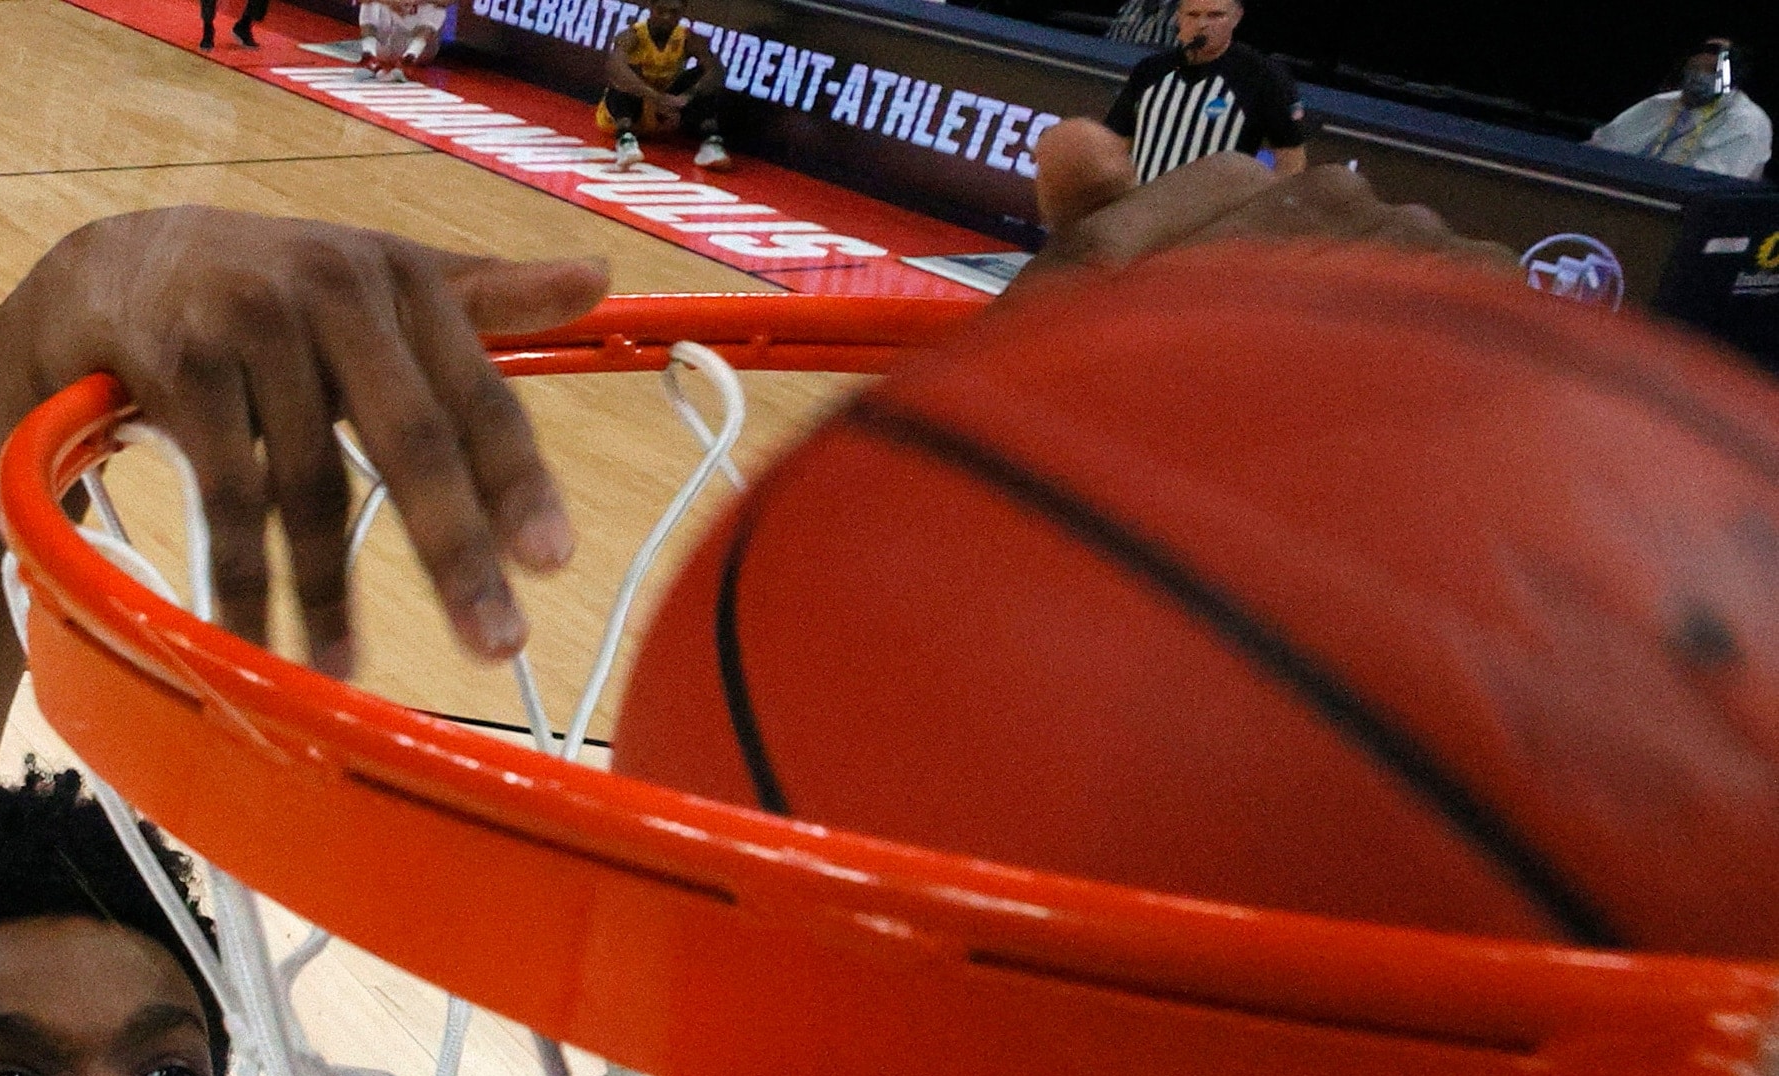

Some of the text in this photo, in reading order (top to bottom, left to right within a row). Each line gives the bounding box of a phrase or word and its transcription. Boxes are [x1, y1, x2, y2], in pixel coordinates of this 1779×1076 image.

[270, 66, 889, 258] INDIANAPOLIS
[472, 0, 1061, 179] LEBRATE TUDENT-ATHLETES
